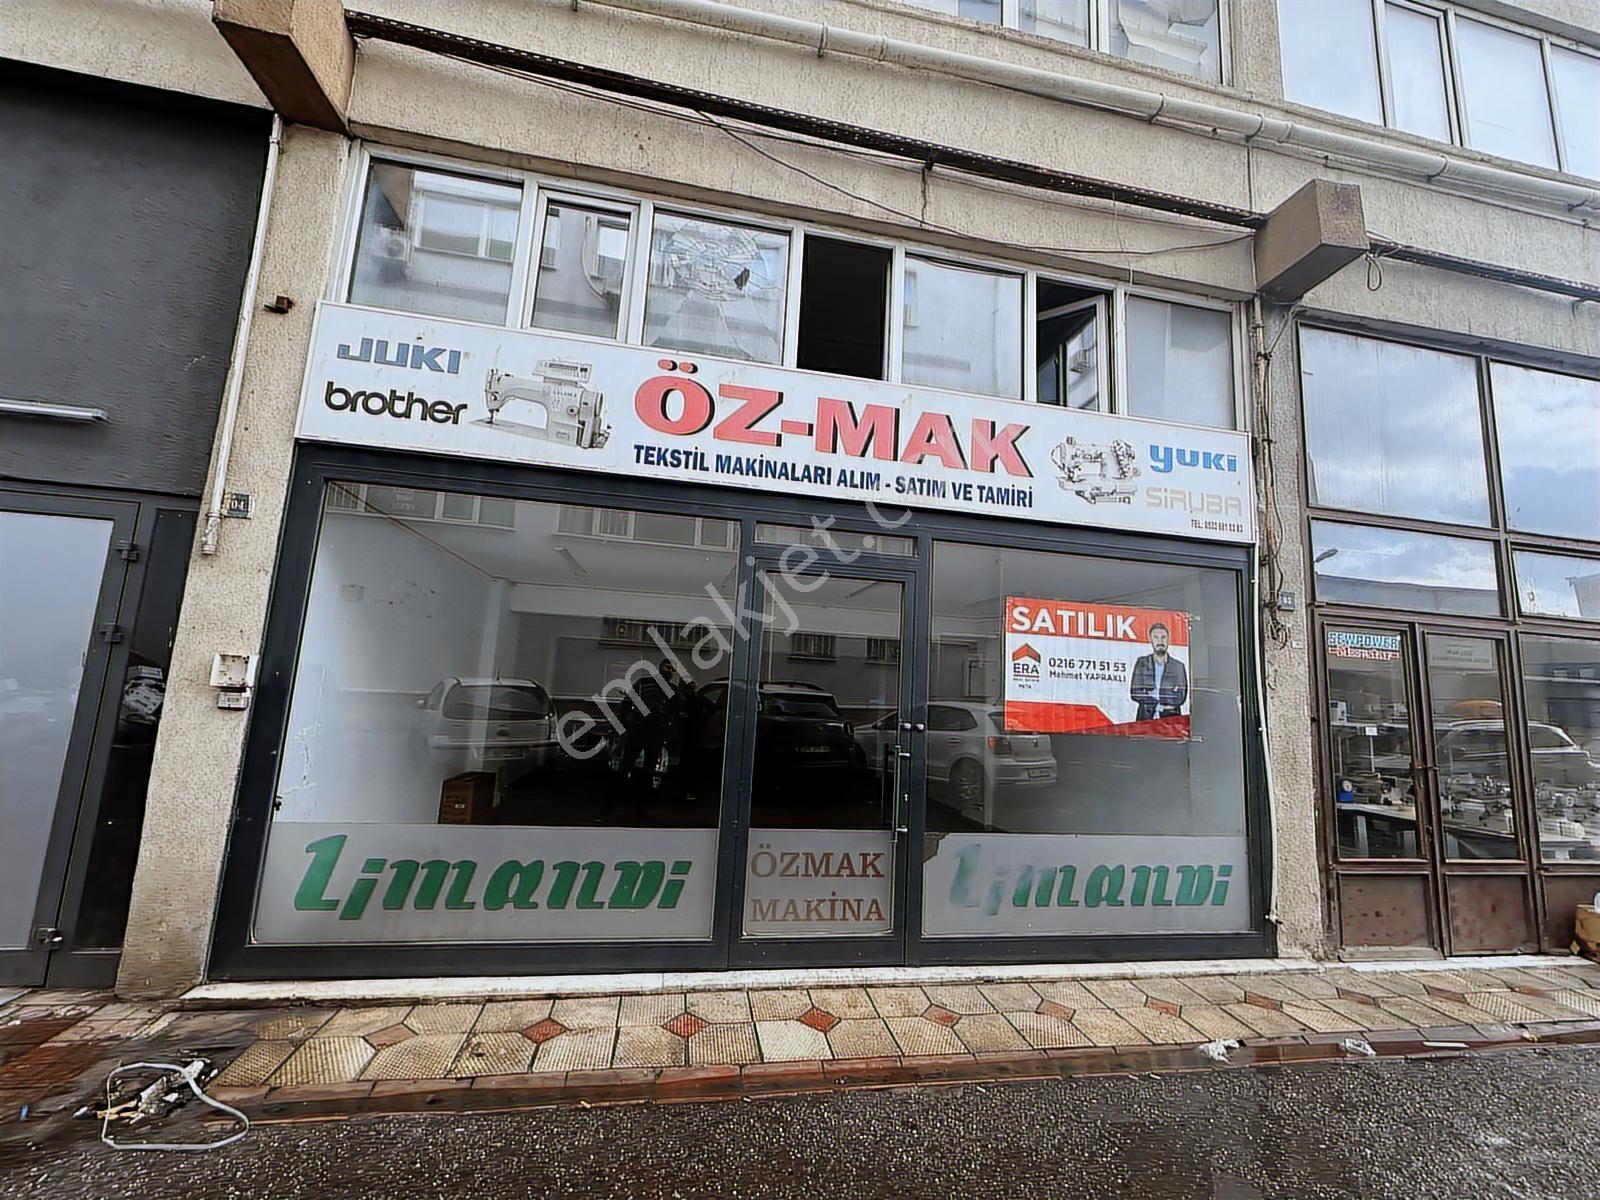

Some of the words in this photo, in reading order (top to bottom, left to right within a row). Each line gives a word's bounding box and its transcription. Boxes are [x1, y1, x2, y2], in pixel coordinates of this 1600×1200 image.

[337, 337, 462, 375] JUKI
[324, 381, 468, 425] brother
[634, 359, 1033, 478] ÖZ-MAK
[634, 445, 710, 472] TEKSTİL
[715, 454, 832, 485] MAKİNALARI
[837, 468, 880, 491] ALIM
[895, 476, 946, 499] SATIM
[951, 482, 973, 501] VE
[976, 484, 1033, 508] TAMİRİ
[1012, 606, 1137, 639] SATILIK
[1013, 662, 1040, 675] ERA
[1048, 657, 1075, 669] 0216
[1078, 659, 1097, 670] 771
[1100, 661, 1110, 672] 51
[1113, 662, 1127, 673] 53
[751, 843, 885, 878] ÖZMAK
[749, 890, 886, 922] MAKİNA
